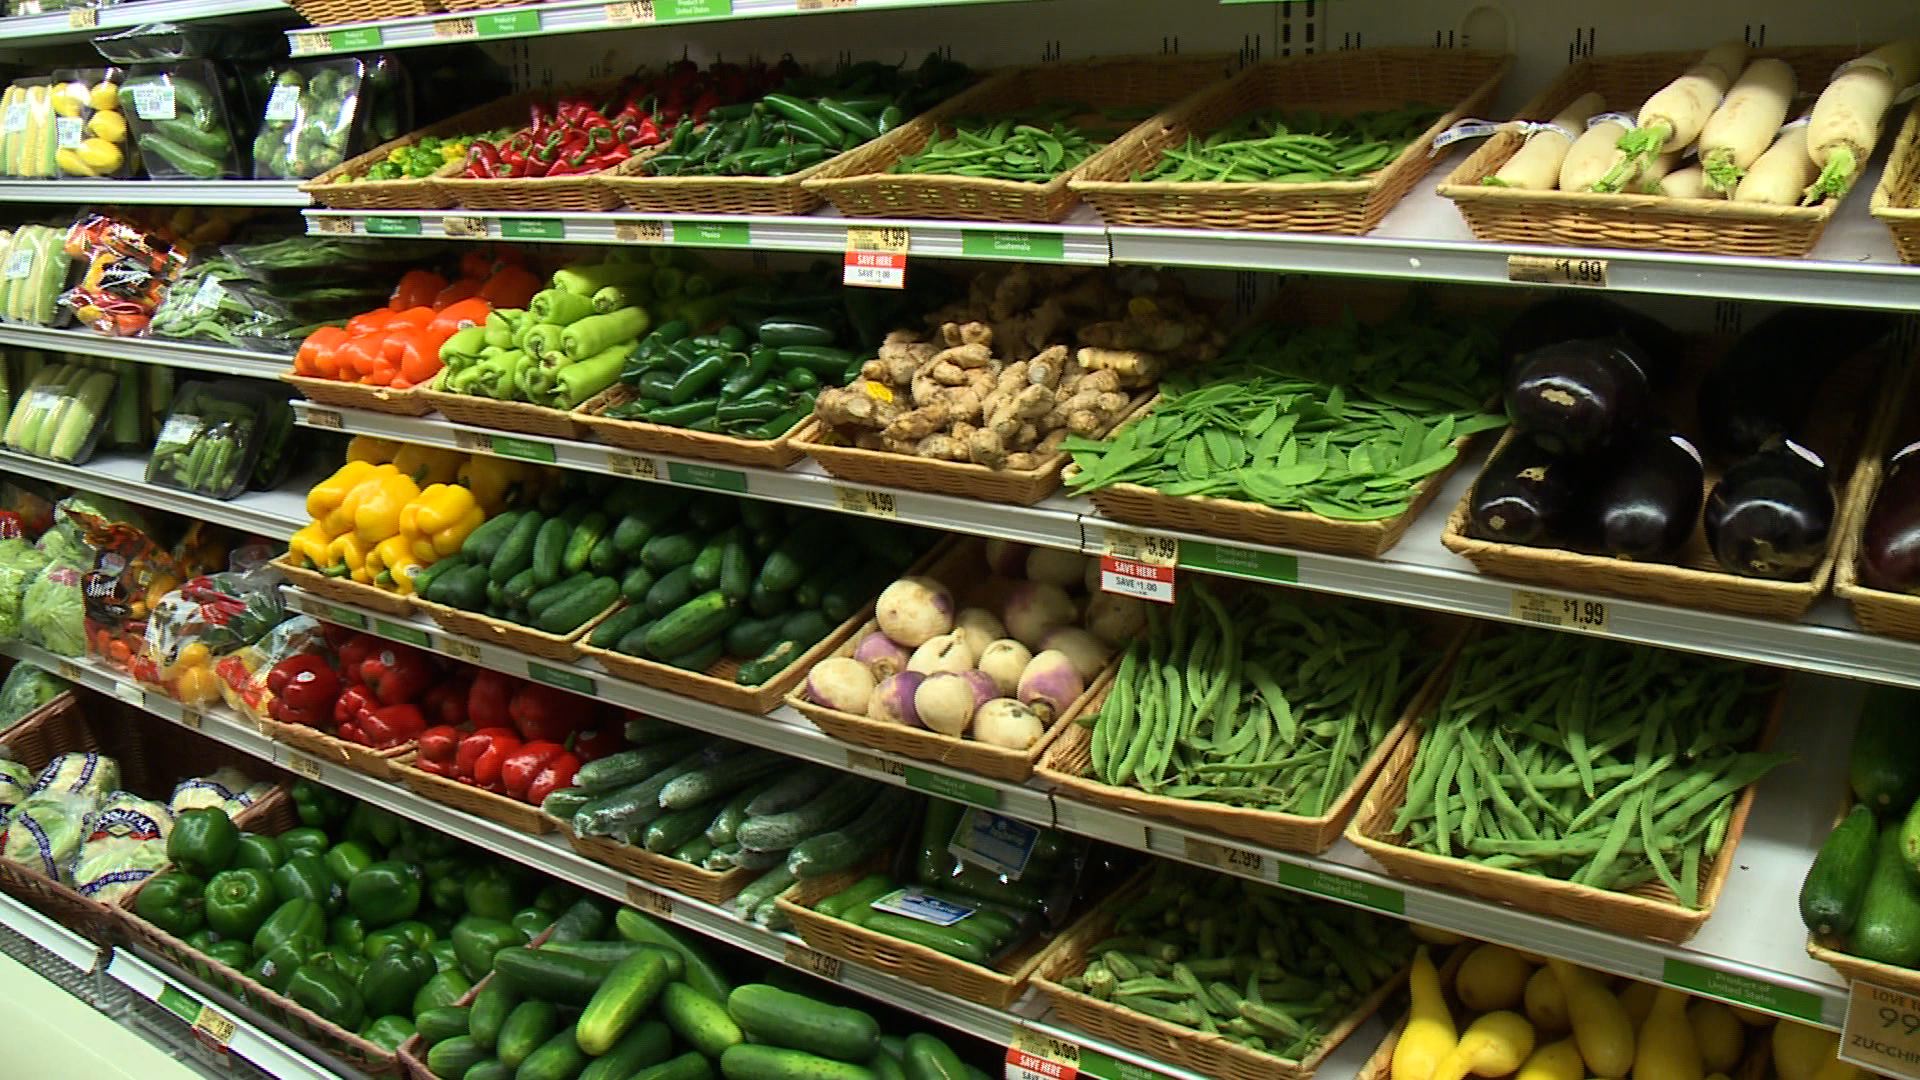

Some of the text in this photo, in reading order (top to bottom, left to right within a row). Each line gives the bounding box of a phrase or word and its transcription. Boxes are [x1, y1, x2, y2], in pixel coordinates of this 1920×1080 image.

[994, 241, 1031, 252] Guatemala
[857, 254, 893, 267] SAVE HERE
[858, 268, 873, 278] SAVE
[1553, 258, 1602, 282] $1.99
[1145, 536, 1175, 559] $5.99
[1115, 561, 1158, 580] SAVE HERE
[1115, 576, 1135, 589] SAVE
[1563, 599, 1604, 626] $1.99
[1716, 973, 1753, 990] Product
[1708, 981, 1776, 1005] United States
[1872, 988, 1904, 1006] LOVE
[1020, 1055, 1061, 1077] SAVE HERE
